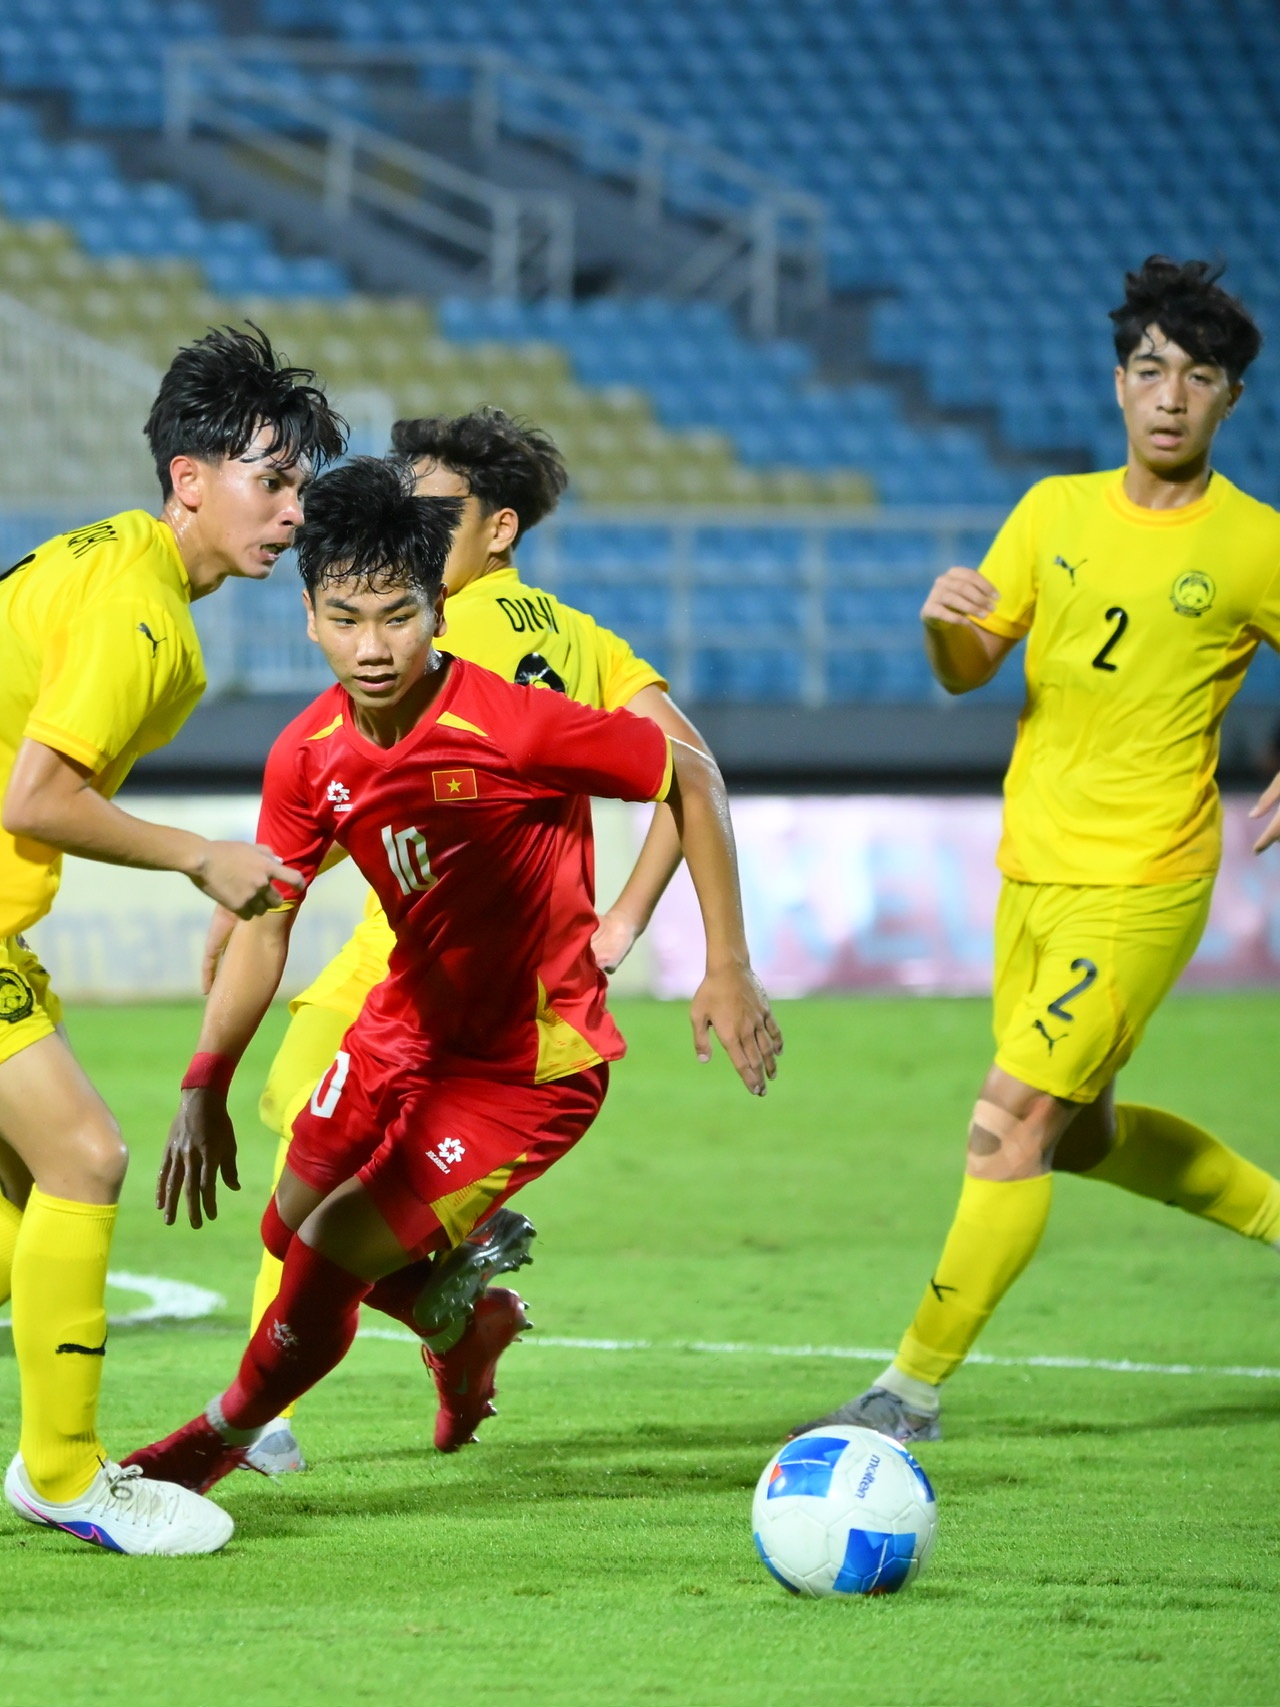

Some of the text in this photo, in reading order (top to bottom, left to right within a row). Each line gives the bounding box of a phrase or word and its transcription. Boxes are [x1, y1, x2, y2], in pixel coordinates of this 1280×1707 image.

[496, 596, 559, 634] DINI
[1092, 606, 1129, 672] 2
[381, 824, 438, 896] 10
[1047, 957, 1097, 1022] 2
[854, 1454, 880, 1499] molten
